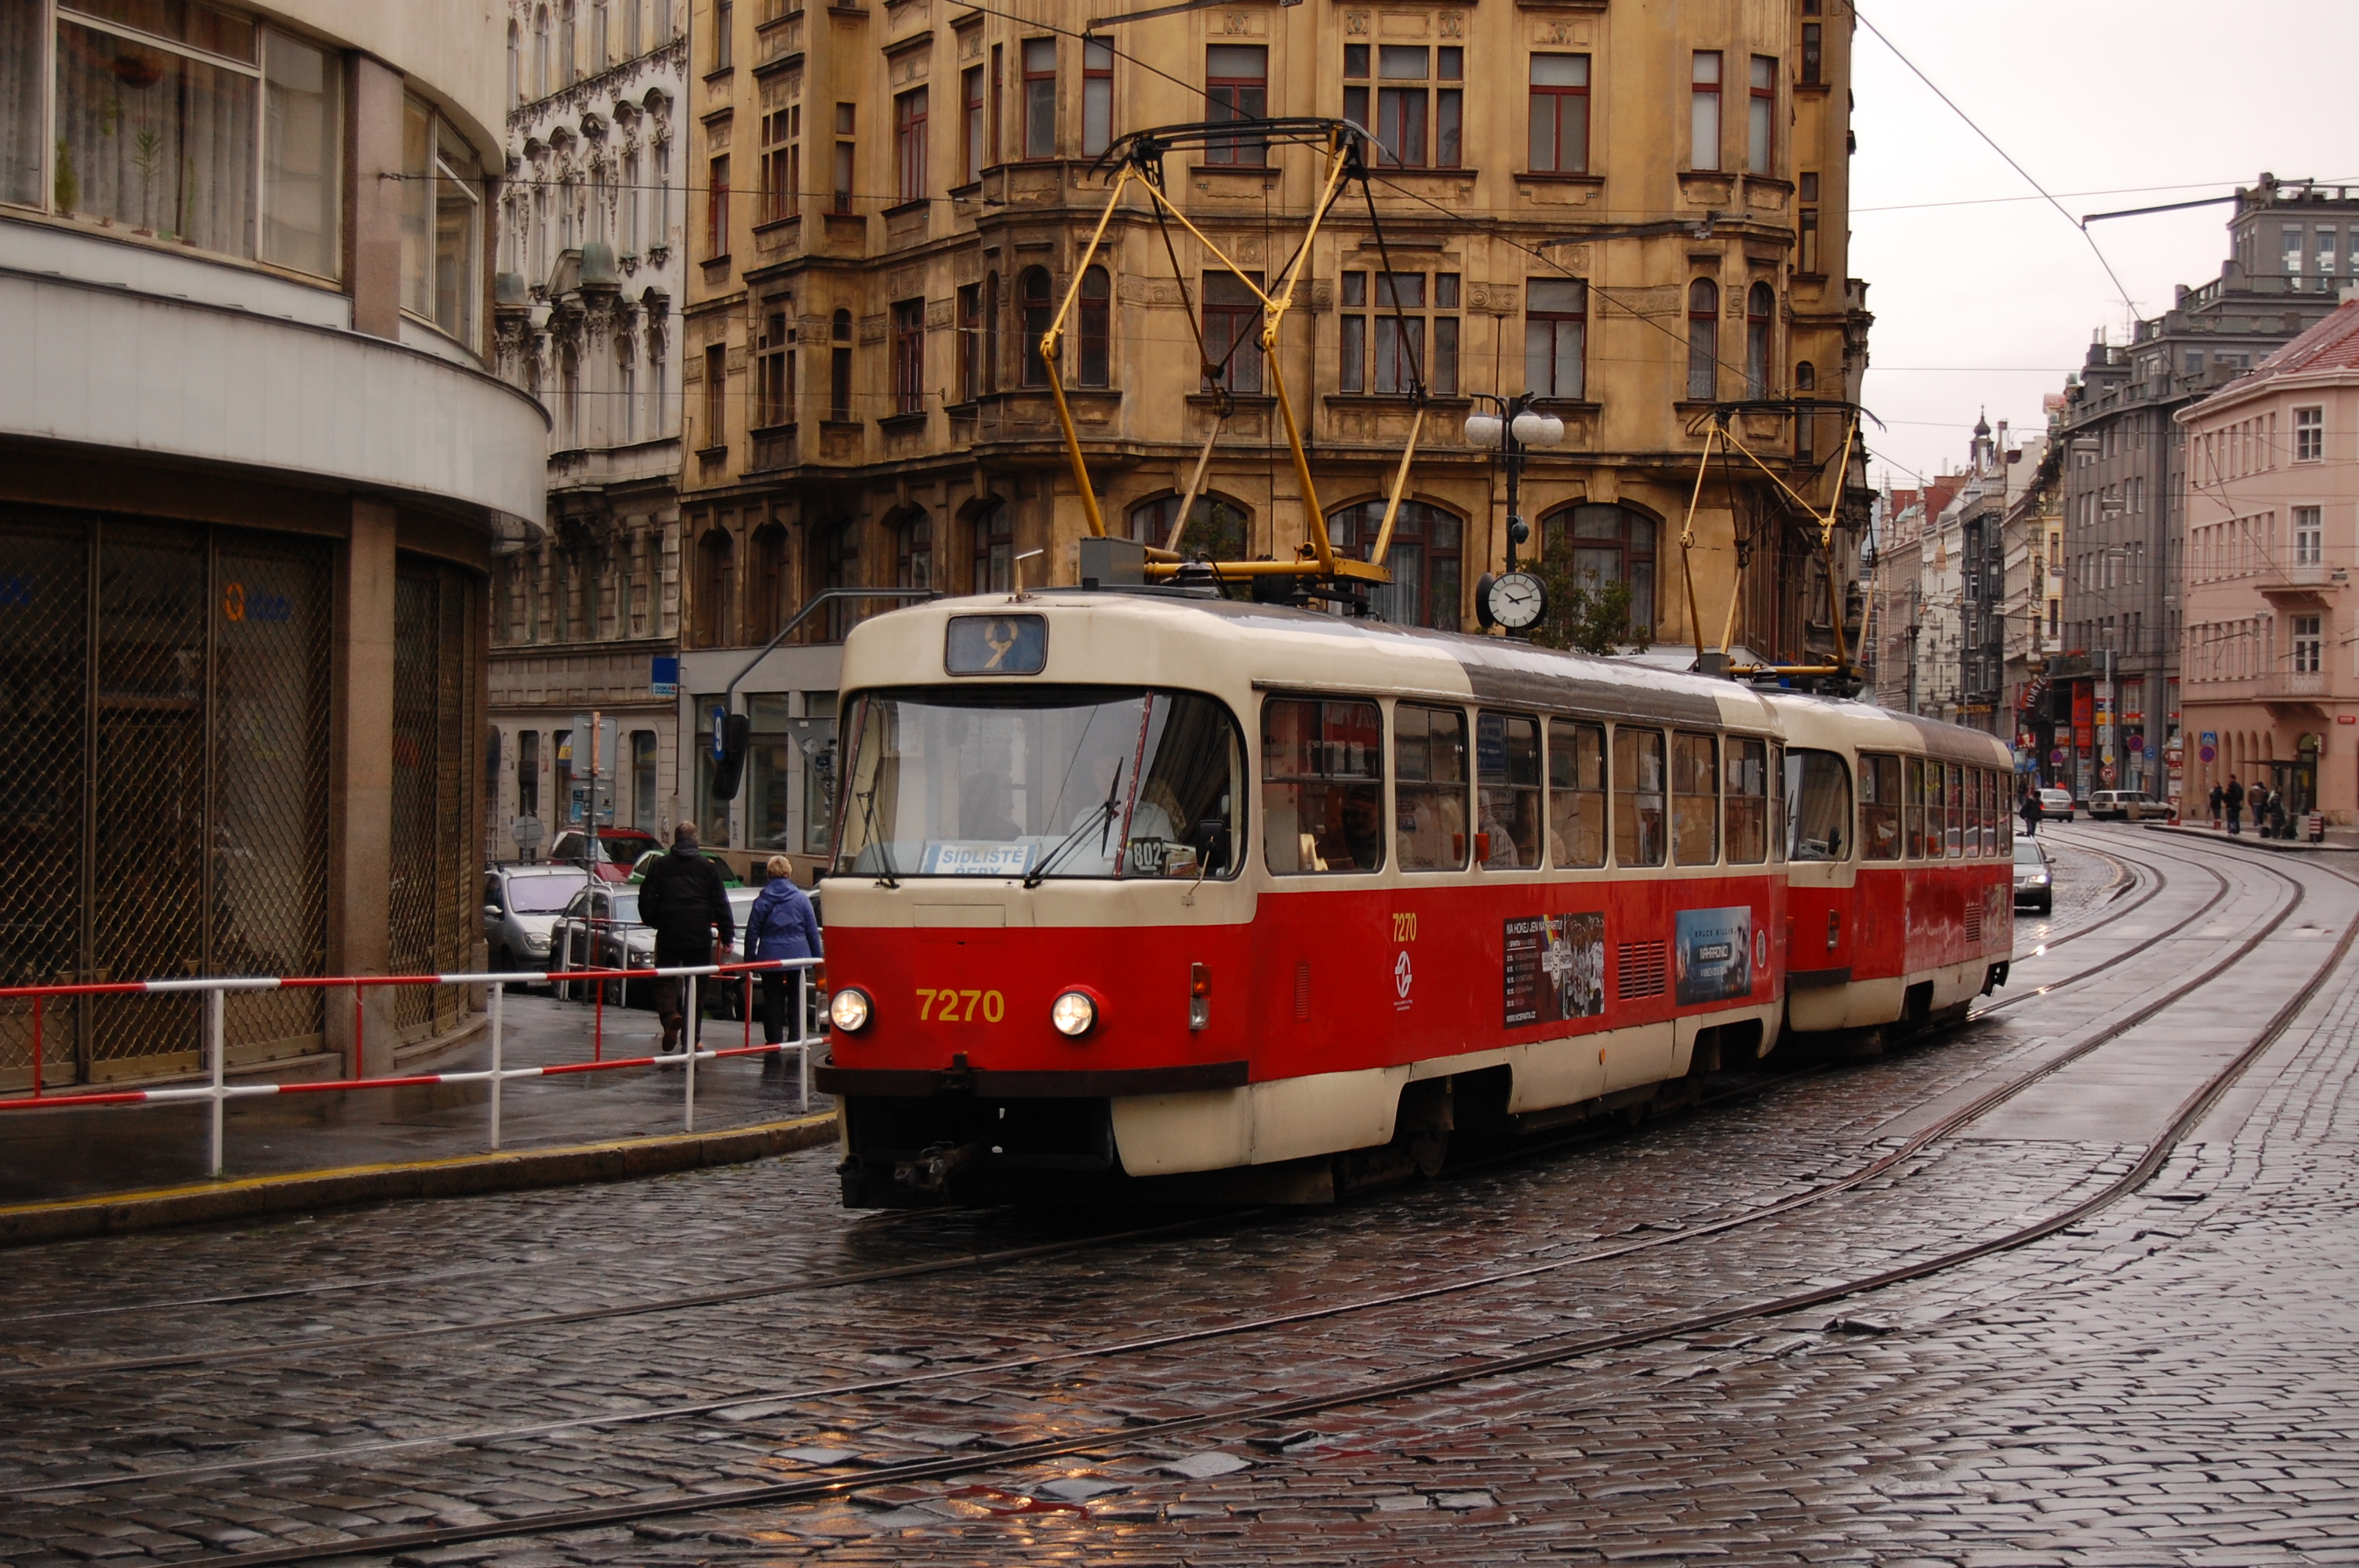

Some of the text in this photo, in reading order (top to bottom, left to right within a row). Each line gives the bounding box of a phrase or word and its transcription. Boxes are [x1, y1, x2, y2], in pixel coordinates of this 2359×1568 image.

[984, 618, 1018, 669] 9
[716, 717, 722, 752] 9
[943, 847, 1024, 864] SÍDLIŠTĚ
[1133, 841, 1162, 867] 802
[1393, 913, 1417, 942] 7270
[1695, 927, 1734, 938] BRUCE WILLIS
[916, 988, 1005, 1022] 7270
